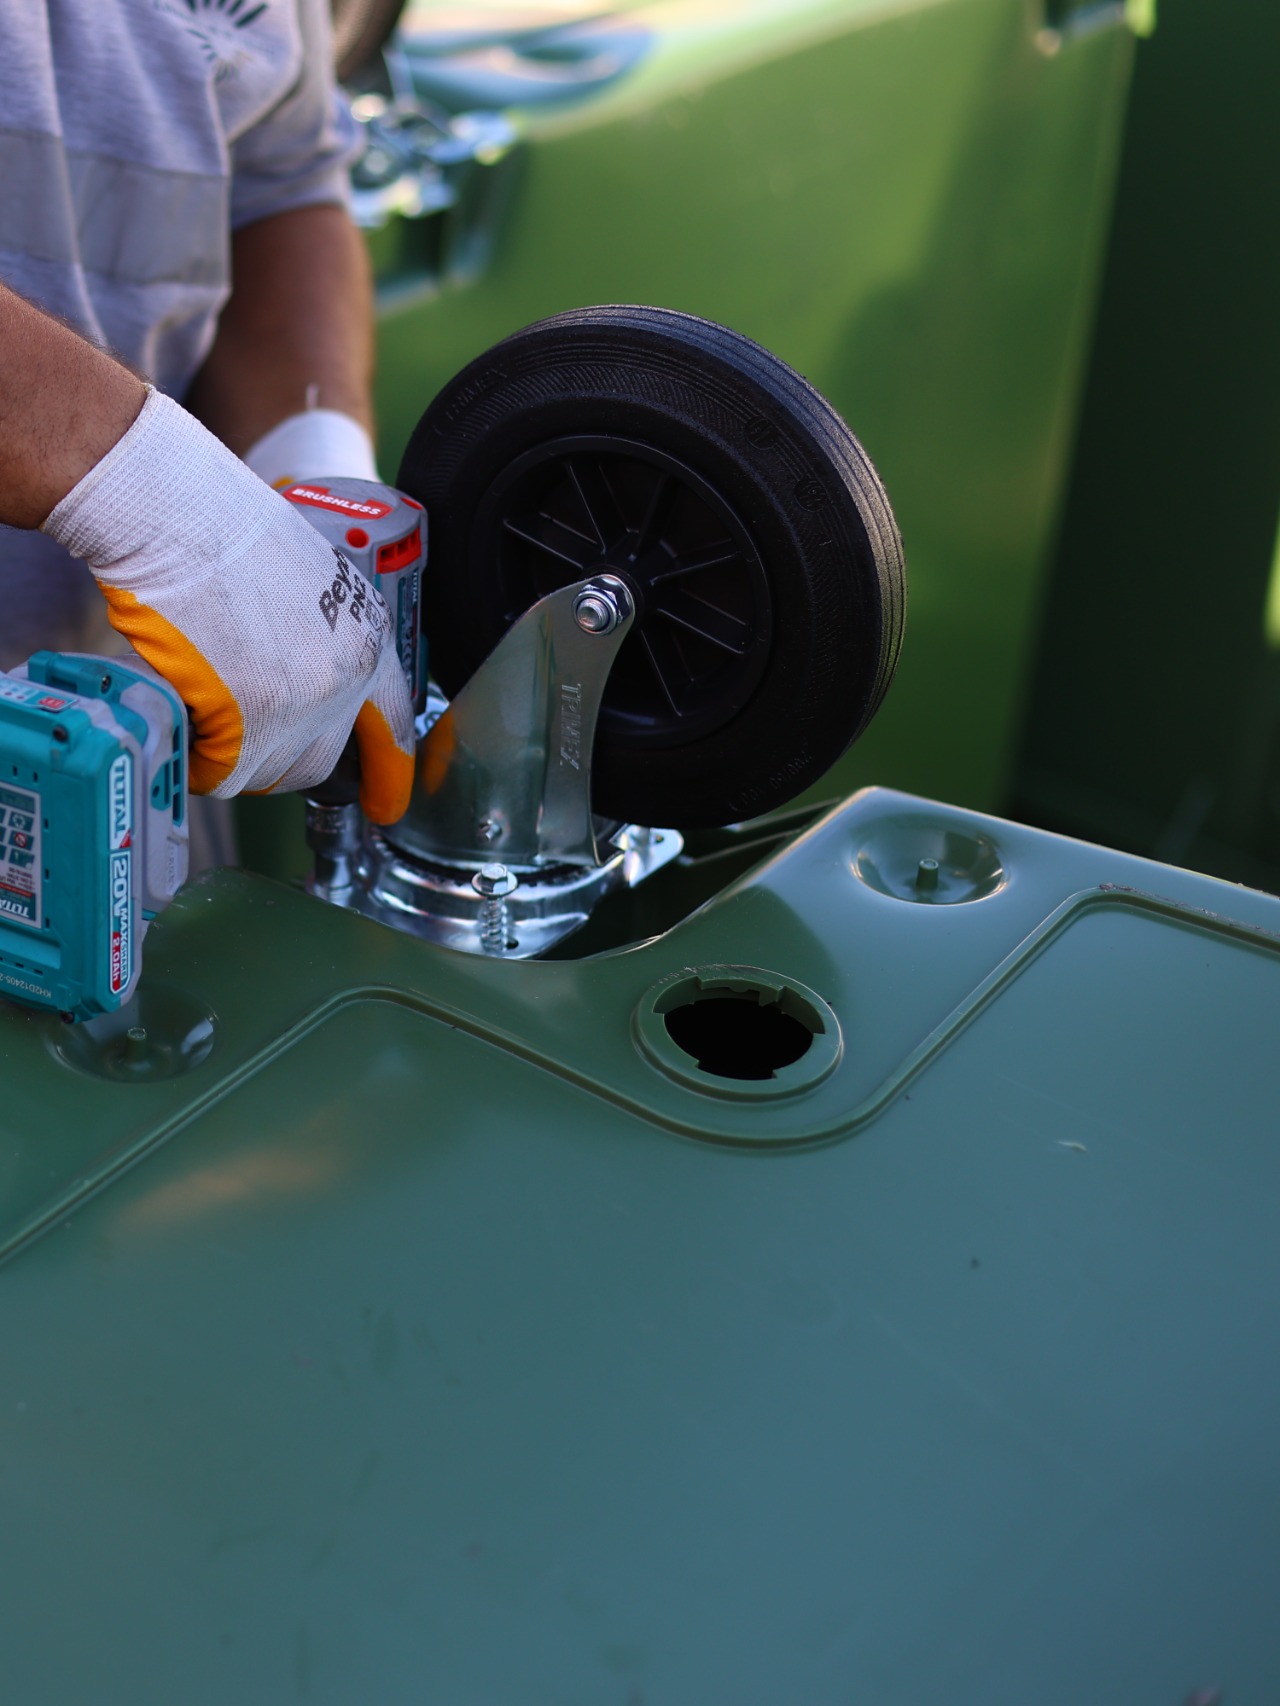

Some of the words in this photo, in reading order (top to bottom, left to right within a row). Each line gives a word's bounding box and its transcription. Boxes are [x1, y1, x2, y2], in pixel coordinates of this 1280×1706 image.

[292, 488, 381, 515] BRUSHLESS
[559, 683, 581, 770] TRIMEX
[114, 758, 126, 839] TOTAL
[113, 858, 128, 917] 20V
[112, 937, 121, 981] 2.0Ah
